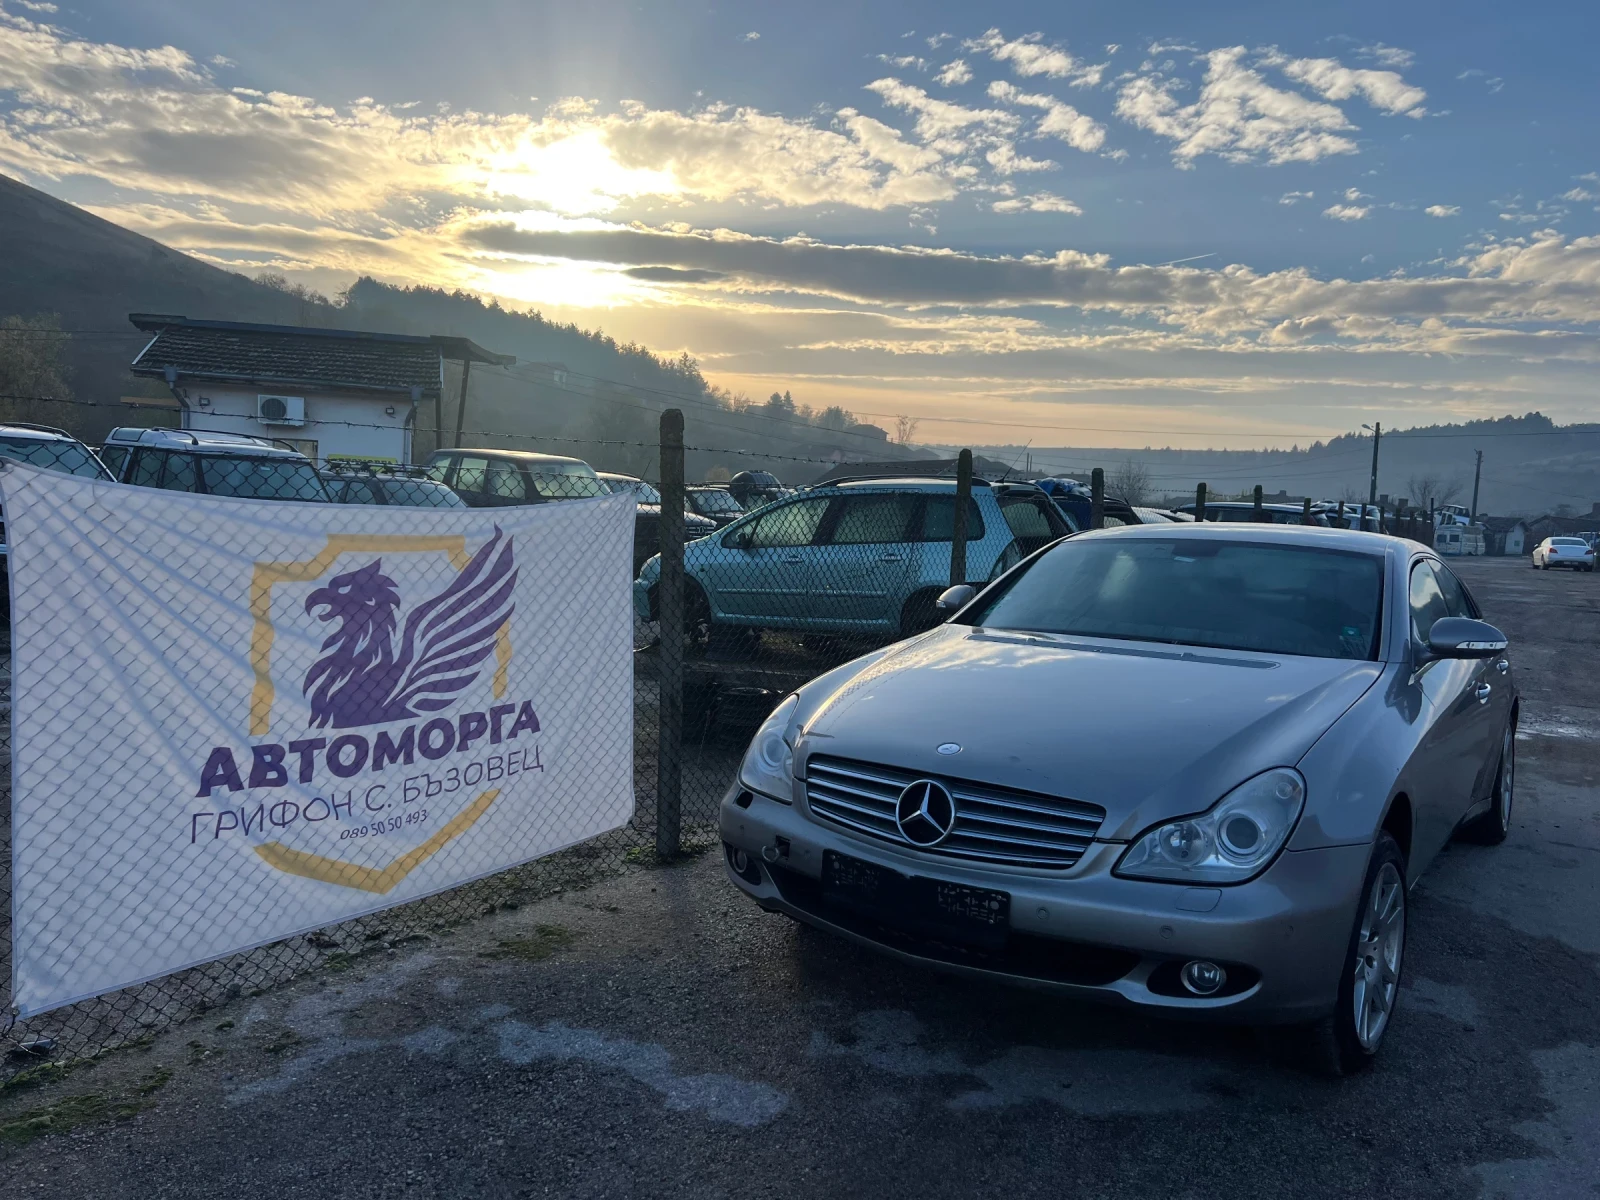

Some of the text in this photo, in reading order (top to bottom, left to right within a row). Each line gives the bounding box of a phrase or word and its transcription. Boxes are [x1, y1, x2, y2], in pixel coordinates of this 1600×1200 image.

[191, 744, 545, 844] ГРИФОН С. БЪЗОВЕЦ
[194, 699, 542, 798] АВТОМОРГА
[340, 809, 428, 840] 089 50 50 493
